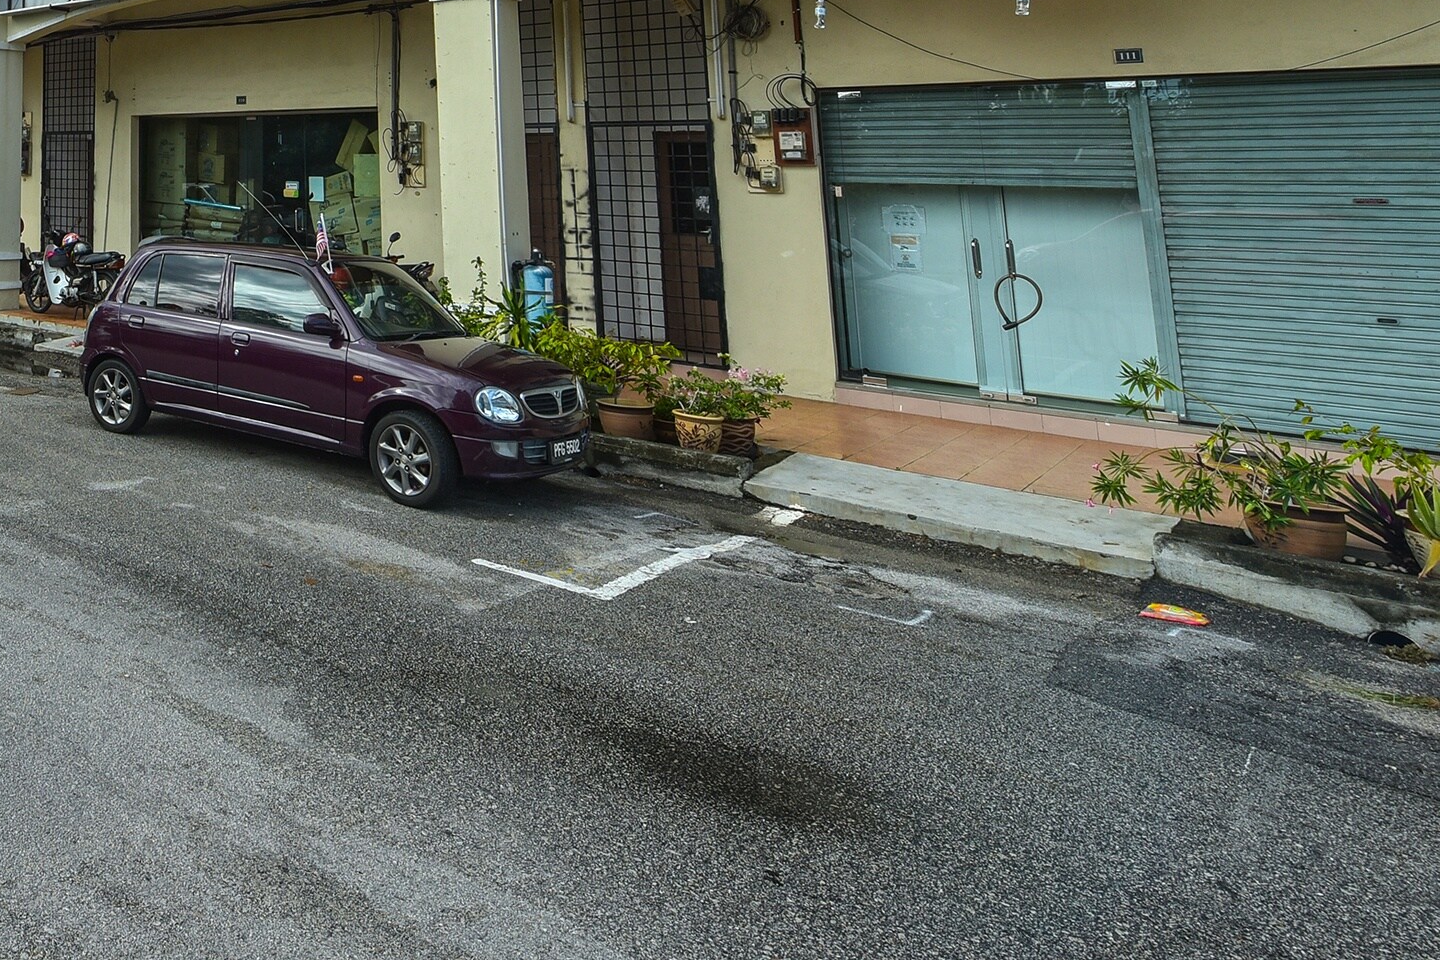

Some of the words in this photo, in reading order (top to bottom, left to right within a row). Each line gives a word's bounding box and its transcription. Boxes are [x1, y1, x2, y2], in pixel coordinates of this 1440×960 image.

[1120, 52, 1136, 60] 111
[554, 442, 566, 458] PFG
[566, 439, 580, 455] 5502
